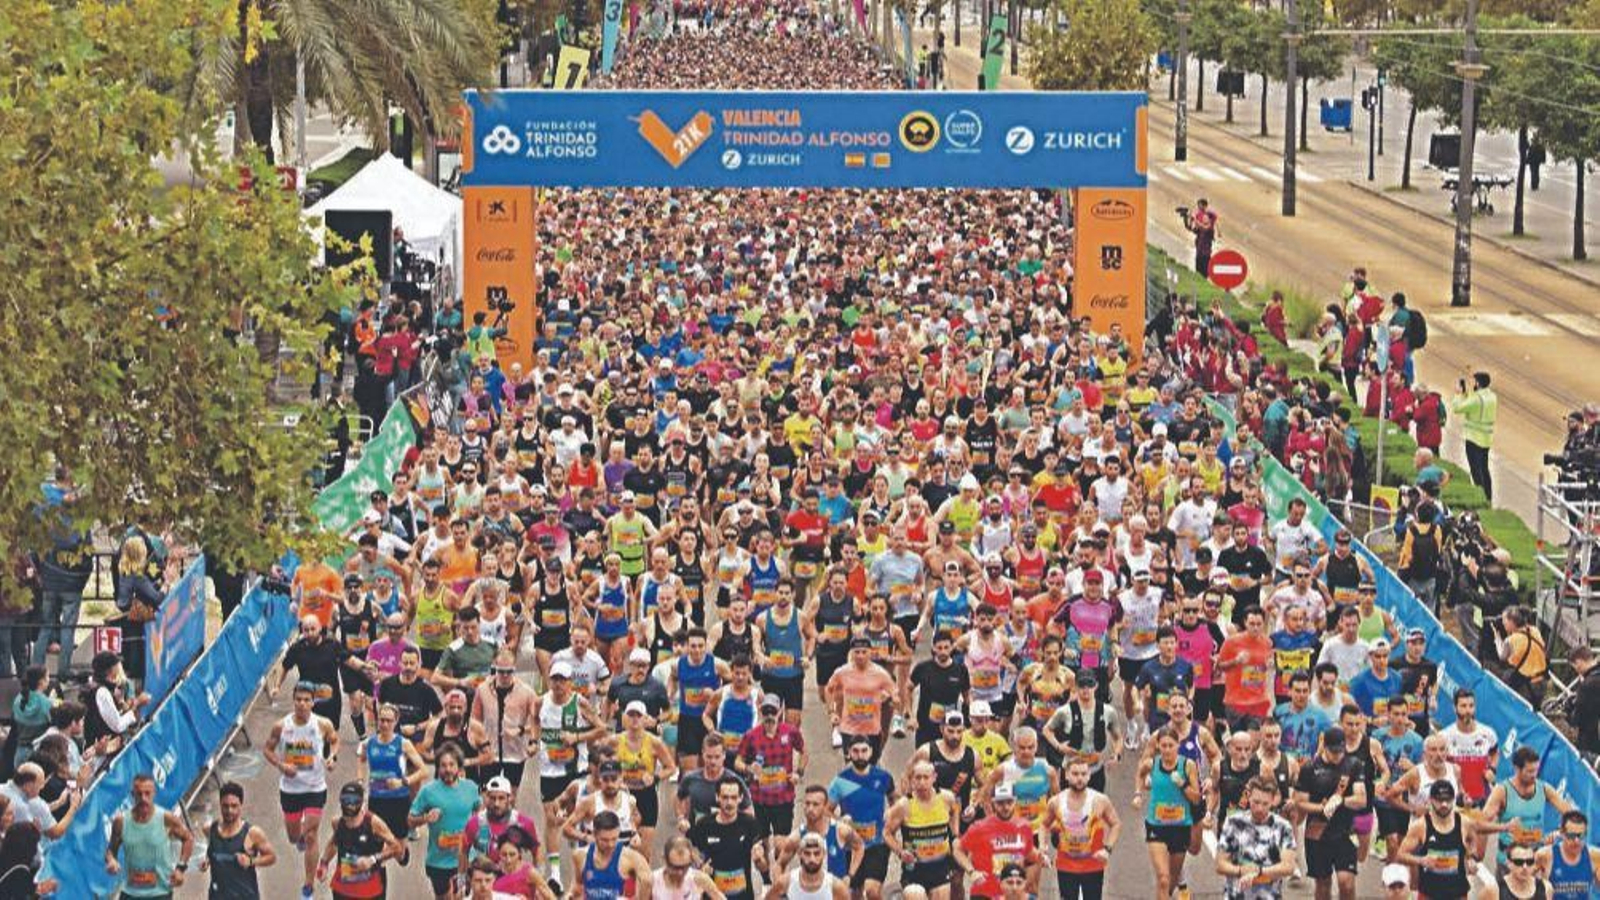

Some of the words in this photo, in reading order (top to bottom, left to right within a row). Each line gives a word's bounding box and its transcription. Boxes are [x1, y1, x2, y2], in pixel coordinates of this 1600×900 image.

[606, 2, 621, 21] 3
[990, 28, 1005, 56] 2
[526, 120, 597, 131] FUNDACIÓN
[723, 109, 801, 127] VALENCIA
[526, 131, 598, 145] TRINIDAD
[723, 131, 804, 146] TRINIDAD
[808, 131, 892, 147] ALFONSO
[1043, 131, 1121, 149] ZURICH
[526, 145, 598, 158] ALFONSO
[747, 153, 801, 166] ZURICH
